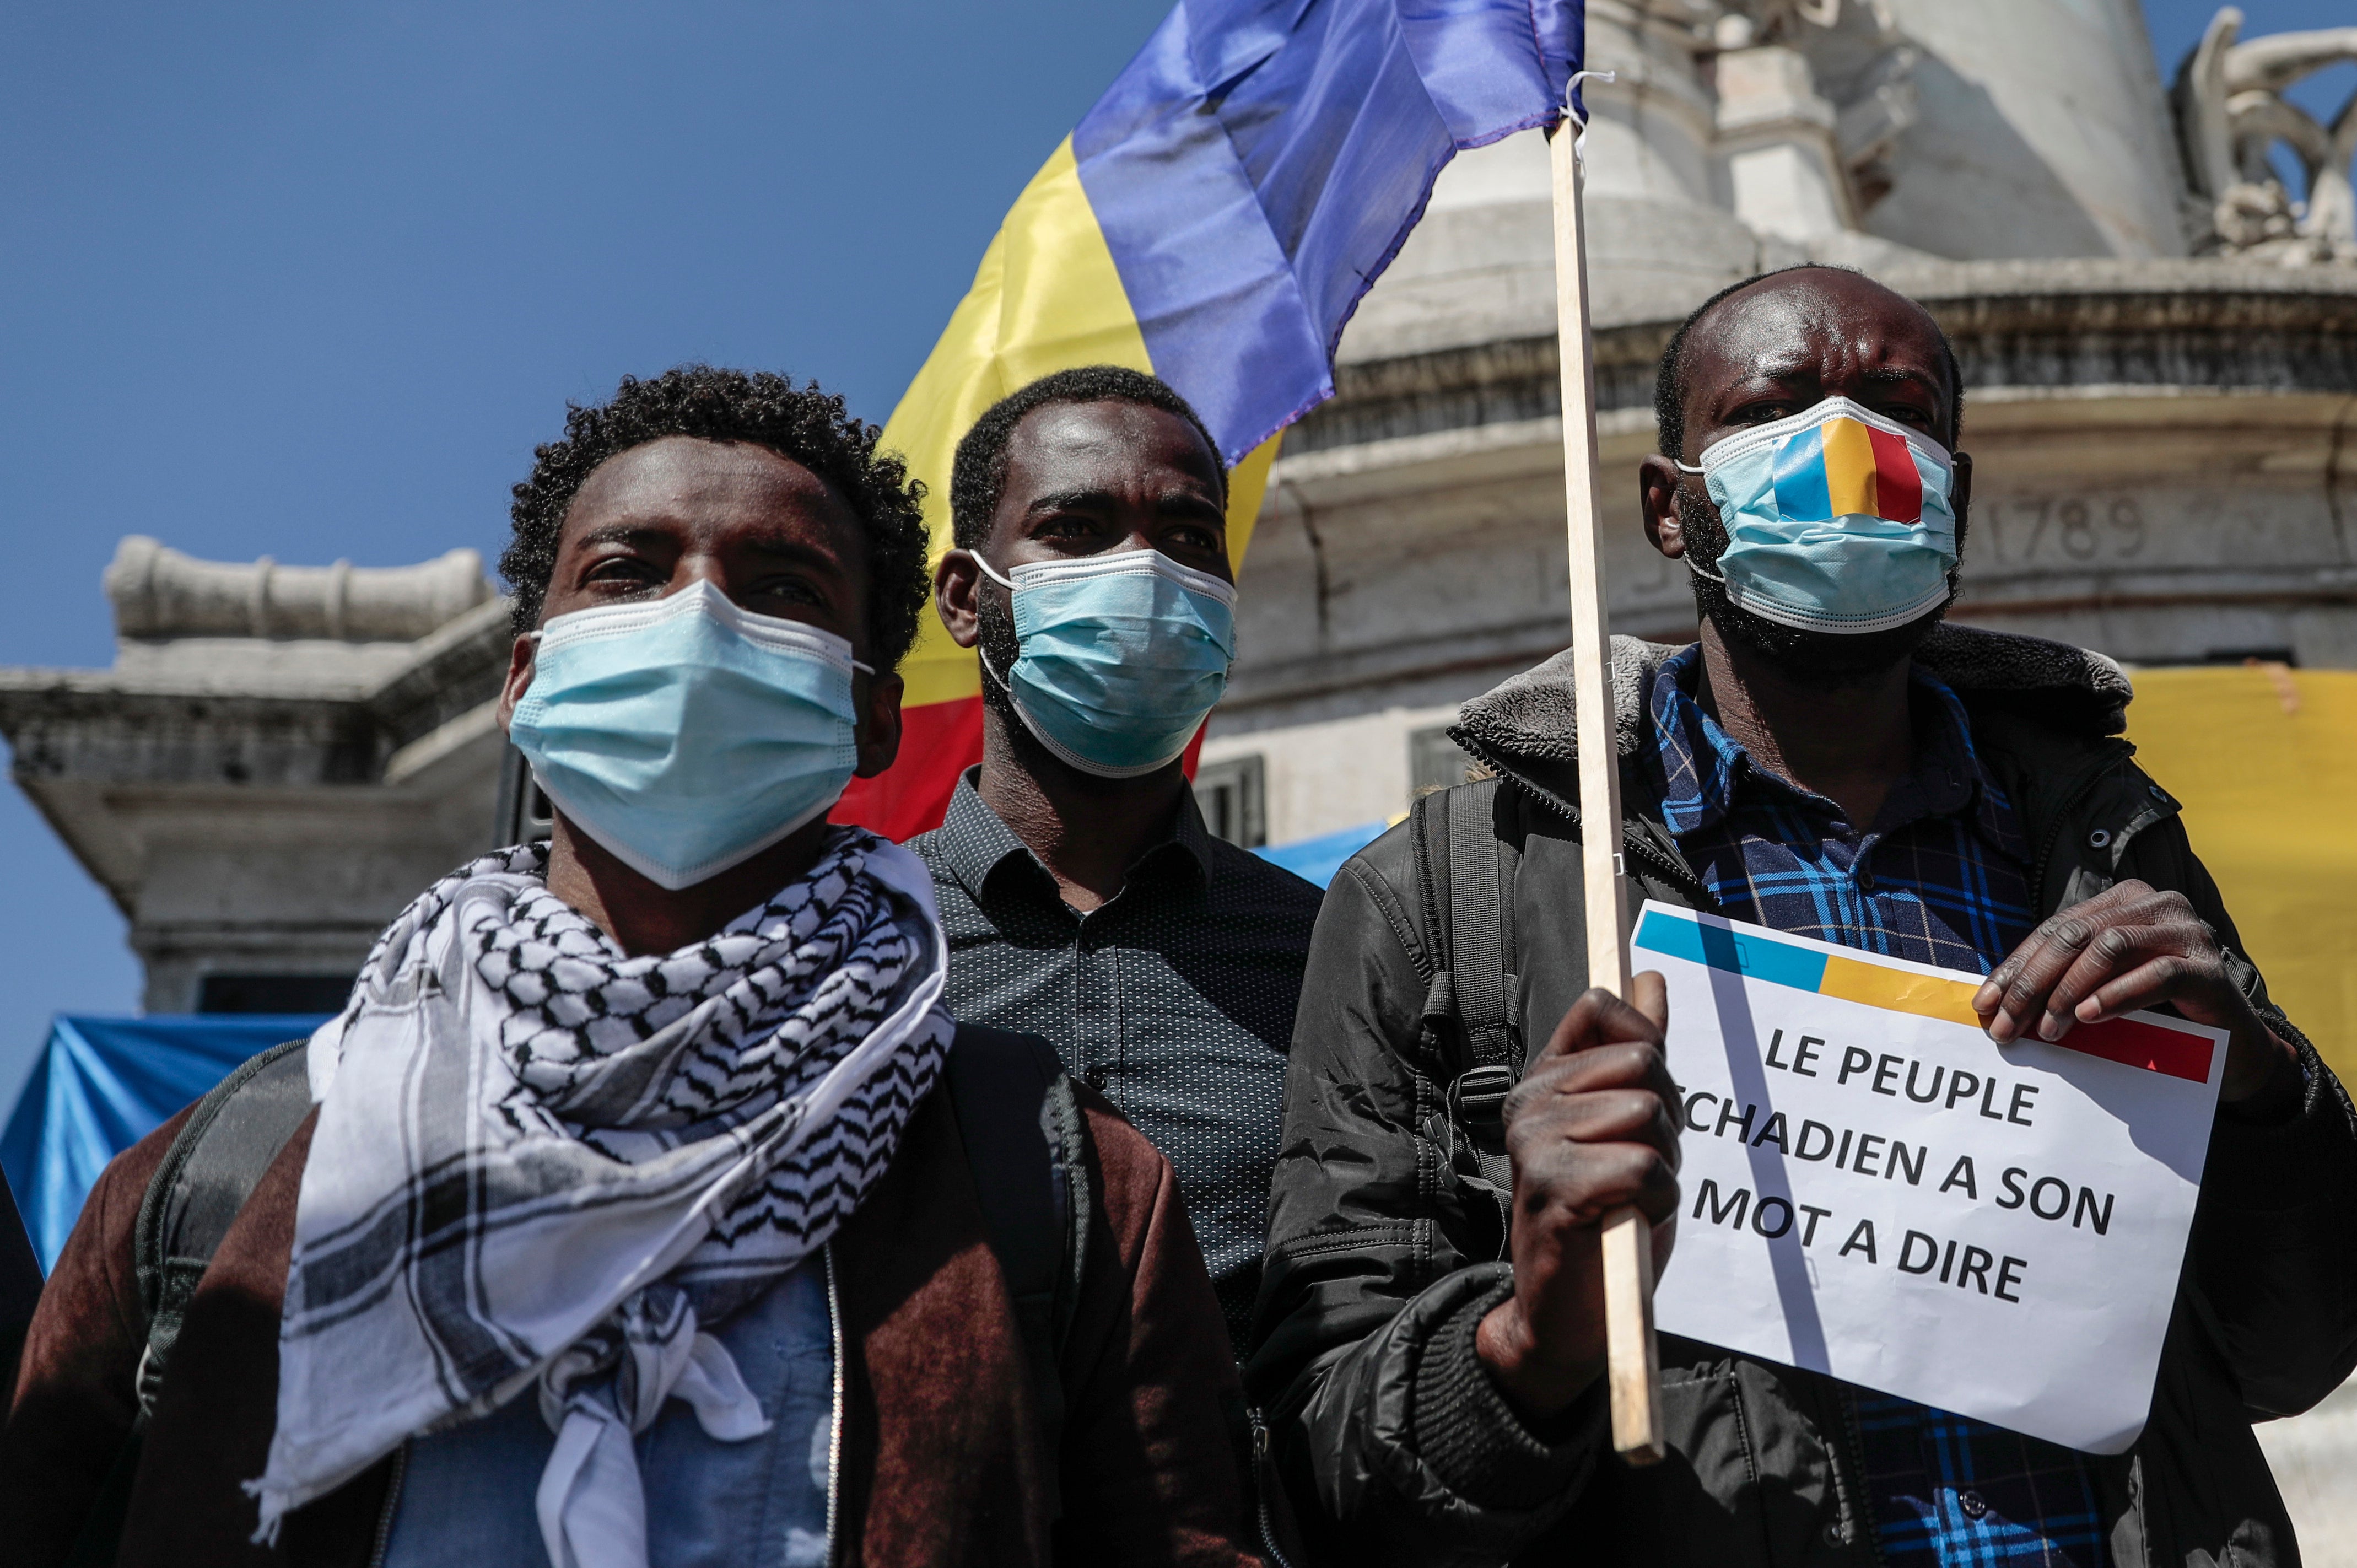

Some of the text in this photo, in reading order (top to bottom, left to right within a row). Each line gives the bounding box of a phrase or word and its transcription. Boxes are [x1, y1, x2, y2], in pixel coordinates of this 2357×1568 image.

[1987, 496, 2146, 565] 1789
[1766, 1029, 2039, 1126] LE PEUPLE
[1939, 1156, 1977, 1199] A
[1996, 1168, 2115, 1236] SON
[1693, 1179, 2028, 1303] MOT A DIRE
